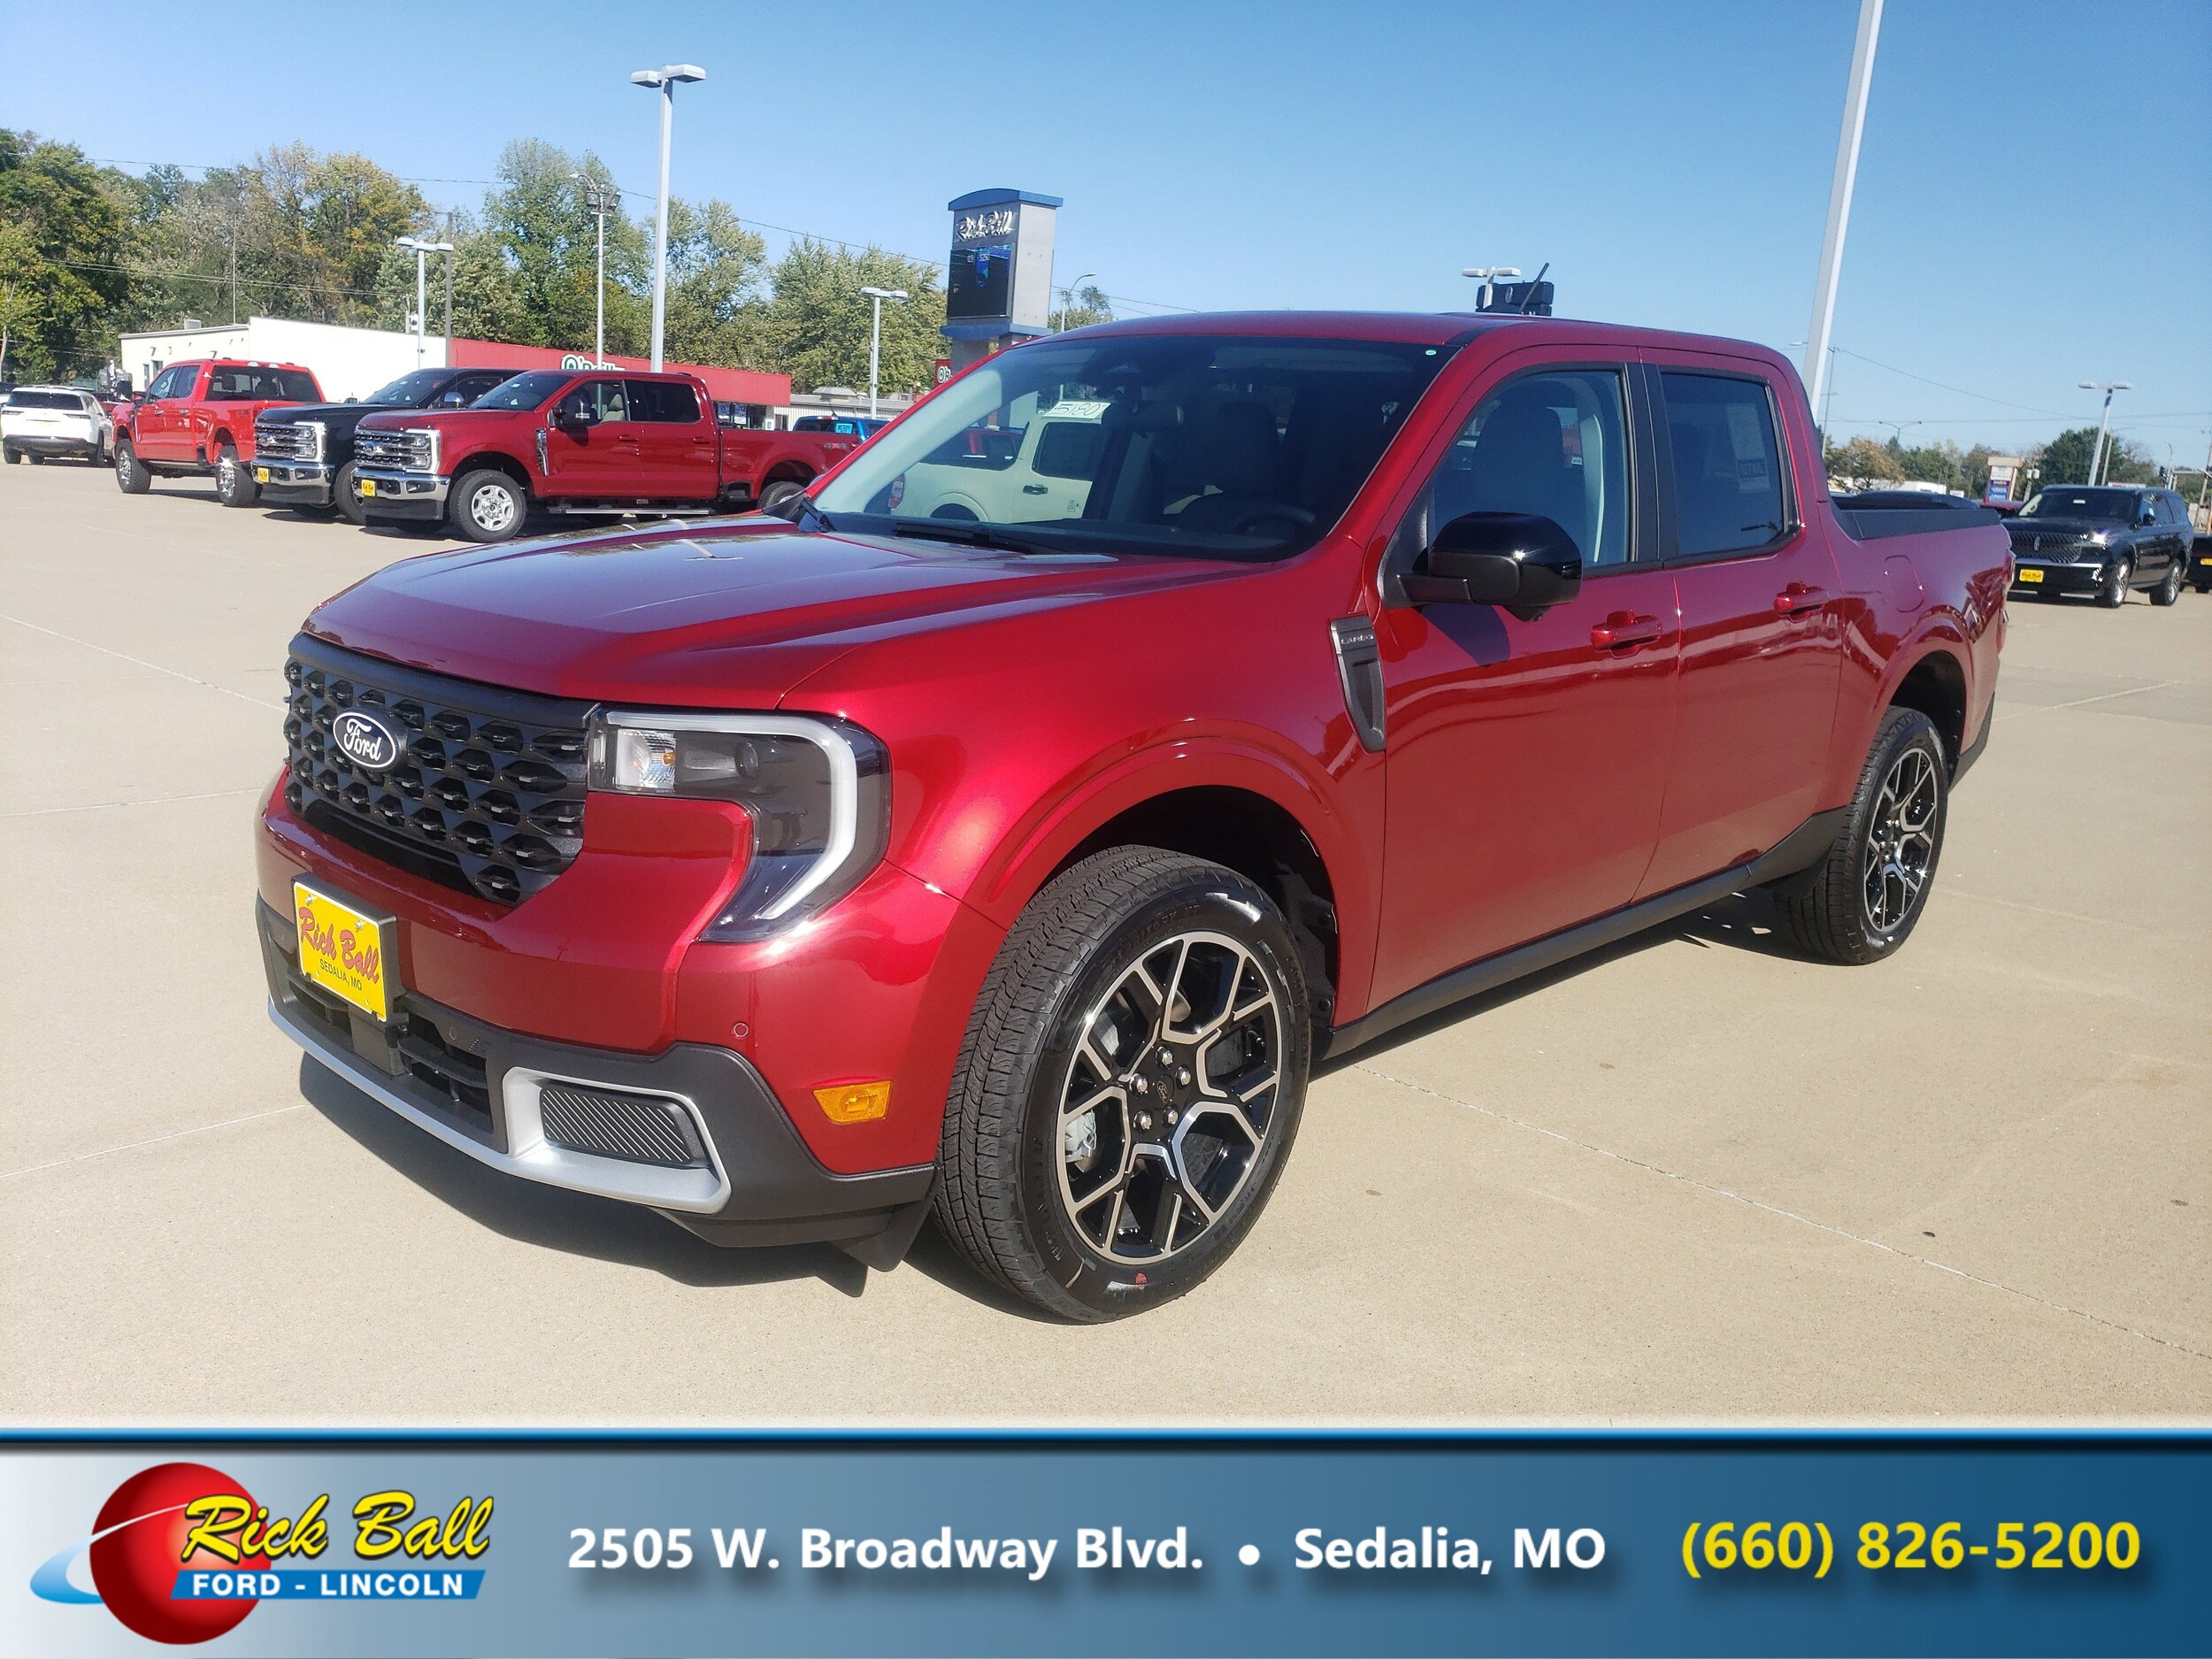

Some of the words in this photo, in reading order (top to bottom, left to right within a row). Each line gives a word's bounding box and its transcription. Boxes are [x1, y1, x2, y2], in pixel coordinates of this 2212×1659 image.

[343, 718, 382, 761] Ford
[298, 906, 337, 961] Rick
[339, 929, 380, 984] Ball
[319, 958, 350, 986] SEDALIA,
[350, 977, 362, 991] MO
